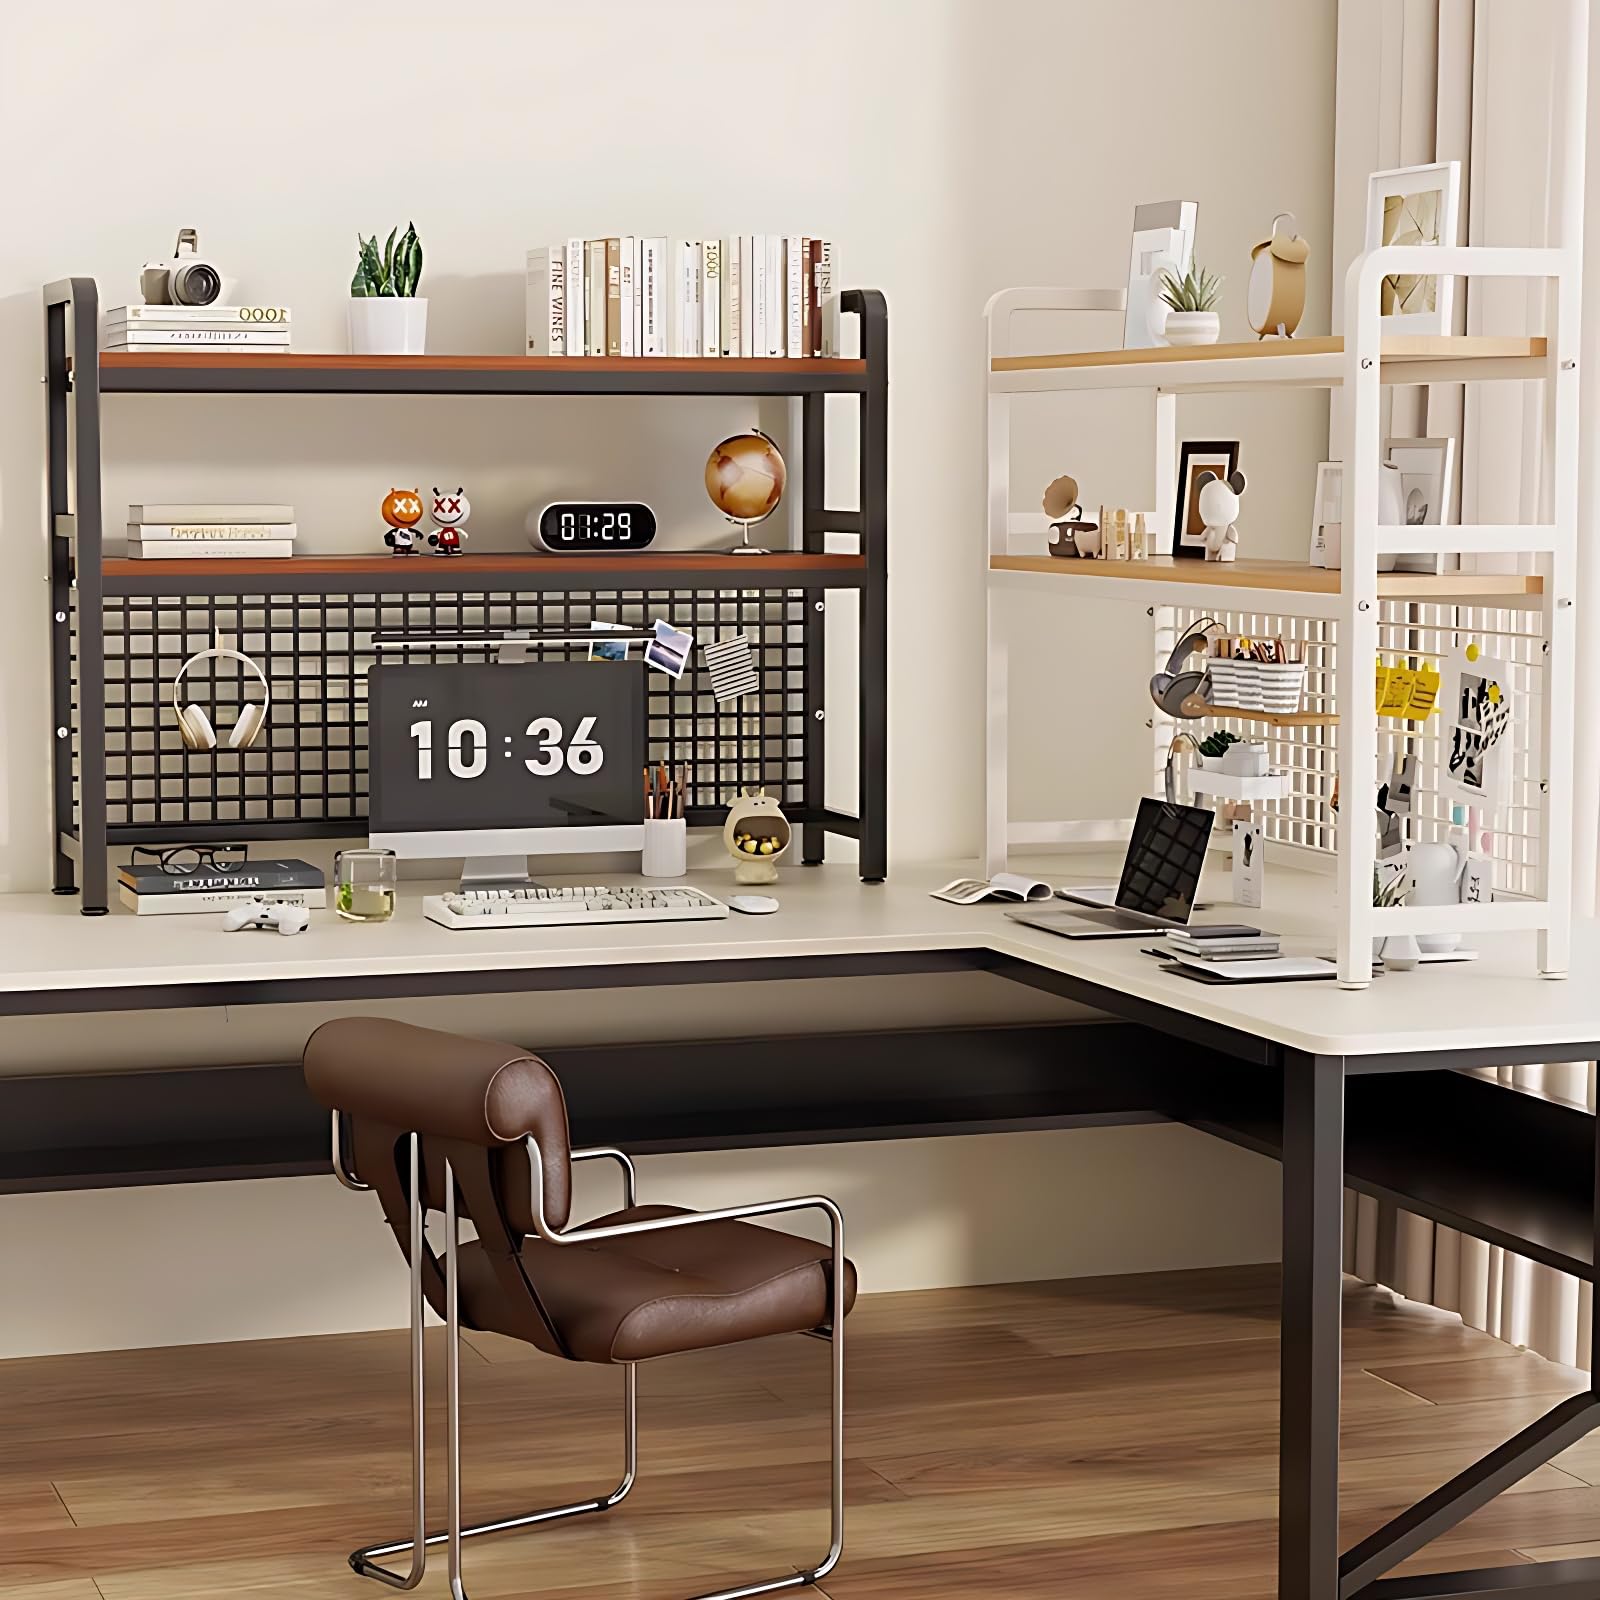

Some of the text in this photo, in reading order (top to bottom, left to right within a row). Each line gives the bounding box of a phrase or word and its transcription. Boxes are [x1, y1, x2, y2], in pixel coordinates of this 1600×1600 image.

[551, 260, 564, 342] FINE WINES
[561, 513, 631, 541] 01:29
[410, 716, 604, 780] 10:36
